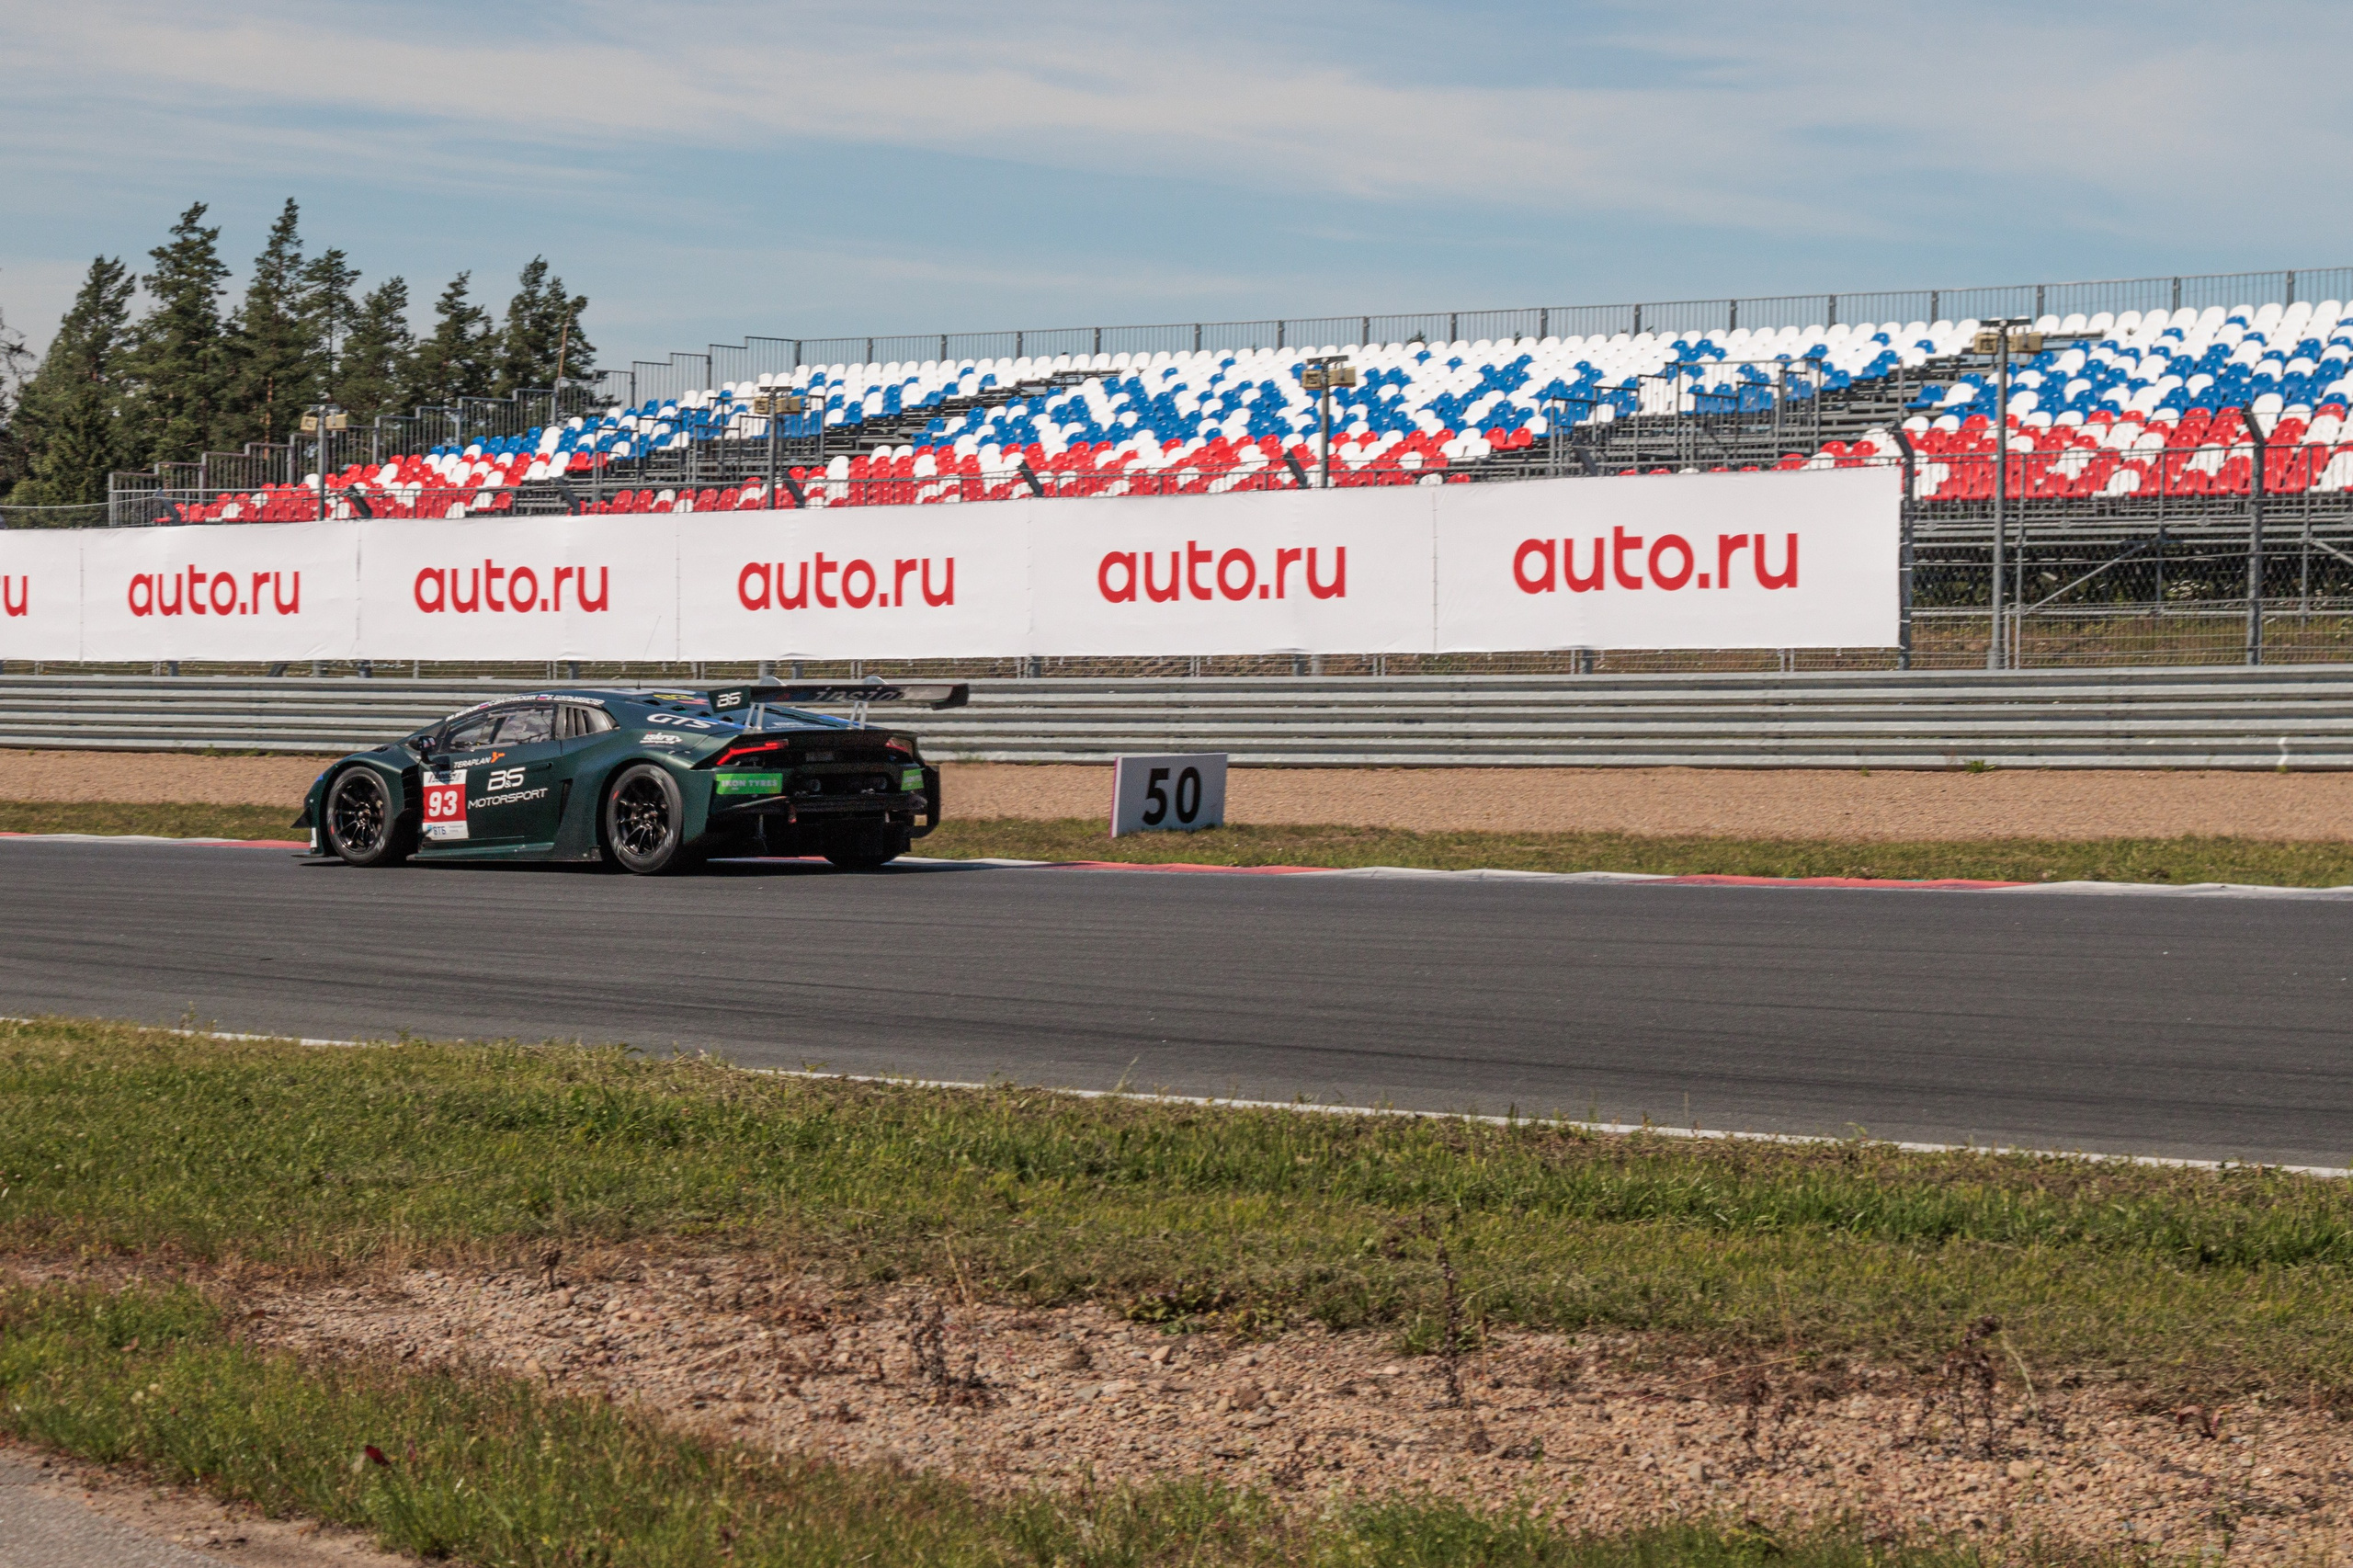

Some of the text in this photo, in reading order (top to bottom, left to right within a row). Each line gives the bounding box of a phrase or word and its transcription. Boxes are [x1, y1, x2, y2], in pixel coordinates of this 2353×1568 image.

[737, 551, 955, 610] auto.ru
[1097, 540, 1347, 604] auto.ru
[1513, 525, 1799, 595] auto.ru
[0, 574, 28, 618] u
[128, 563, 301, 617] auto.ru
[414, 558, 609, 614] auto.ru
[646, 713, 718, 729] GTS
[453, 756, 492, 768] TERAPLAN
[721, 779, 746, 788] IKON
[428, 790, 458, 817] 93
[467, 788, 549, 810] MOTORSPORT
[1142, 766, 1201, 826] 50
